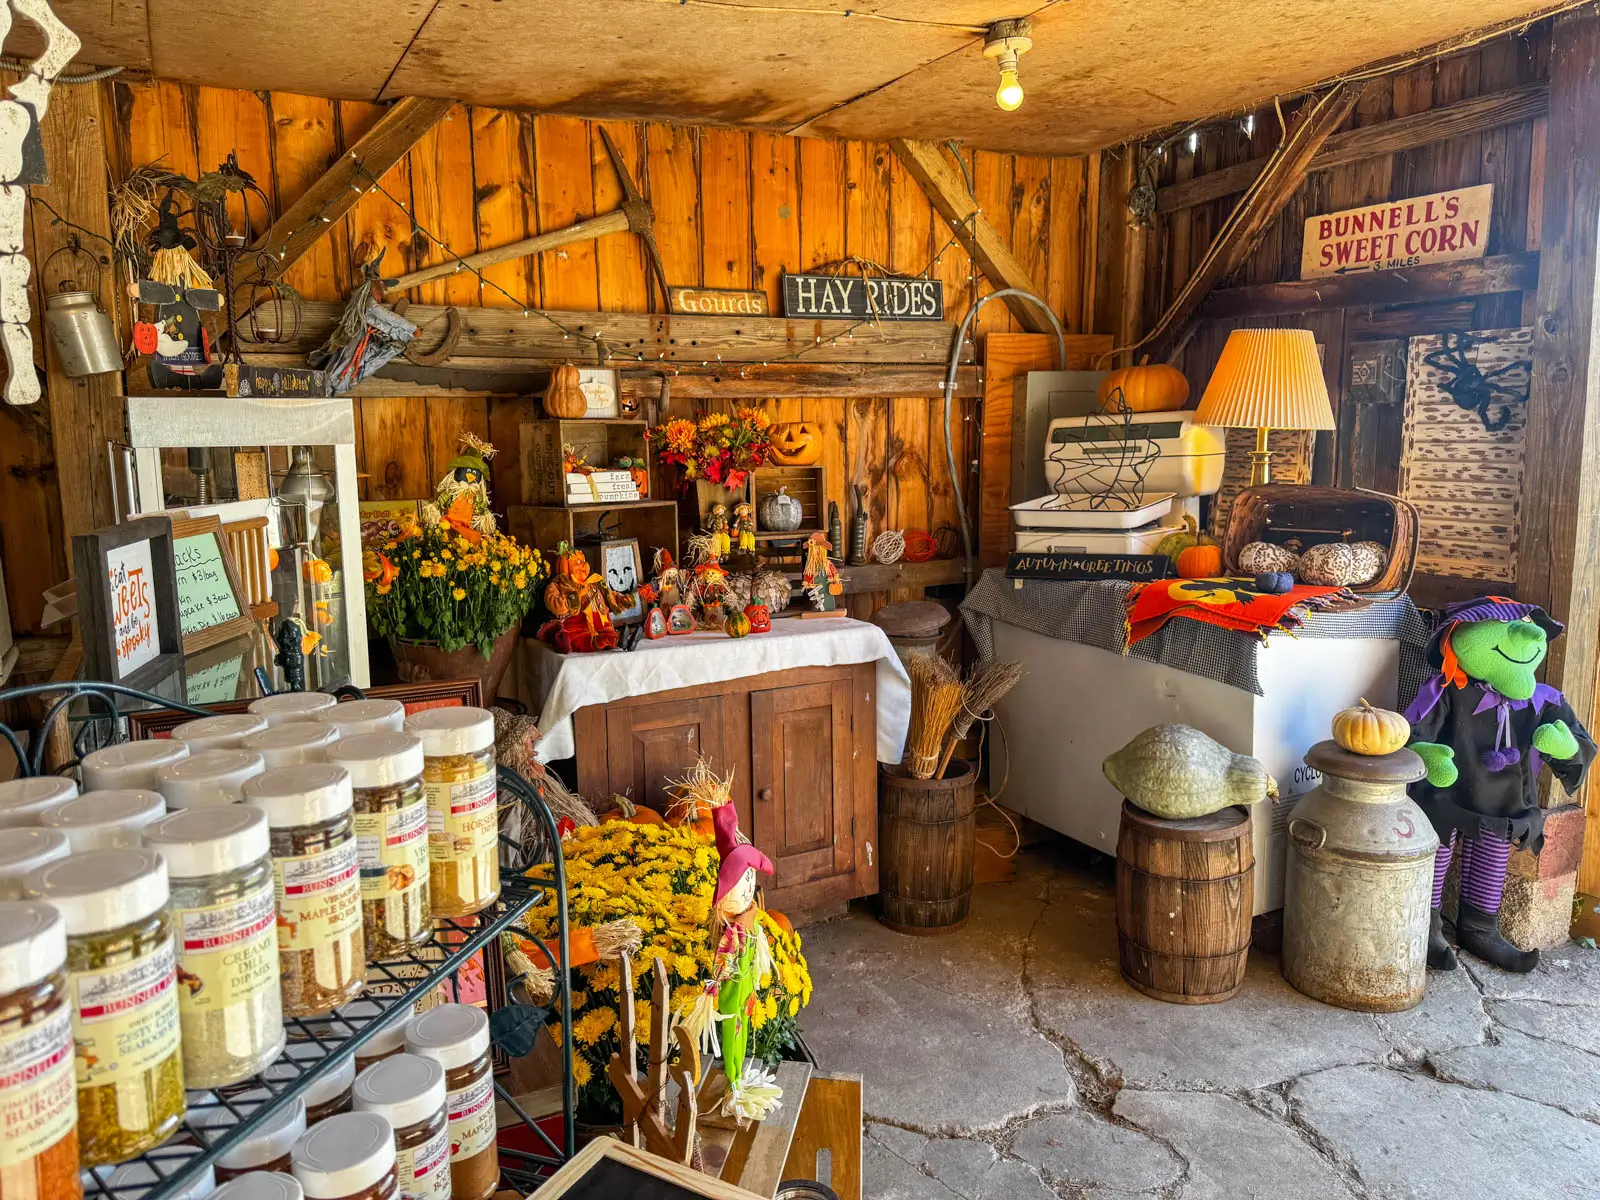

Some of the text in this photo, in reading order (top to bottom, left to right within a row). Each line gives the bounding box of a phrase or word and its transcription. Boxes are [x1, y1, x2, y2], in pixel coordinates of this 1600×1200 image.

[1319, 196, 1459, 240] BUNNELL'S
[1320, 220, 1479, 267] SWEET CORN
[1387, 256, 1420, 268] MILES
[679, 289, 762, 315] Gourds
[797, 277, 937, 316] HAY RIDES
[175, 546, 201, 566] acks
[1015, 557, 1153, 575] AUTUMN GREETINGS
[180, 602, 204, 618] upcake
[121, 620, 151, 660] spooky
[1393, 809, 1415, 838] 5
[300, 904, 338, 922] MAPLE
[222, 934, 272, 966] CREAMY
[231, 974, 252, 989] DIP
[252, 962, 271, 978] MIX
[239, 954, 263, 974] DILL
[462, 1120, 487, 1140] MAPLE
